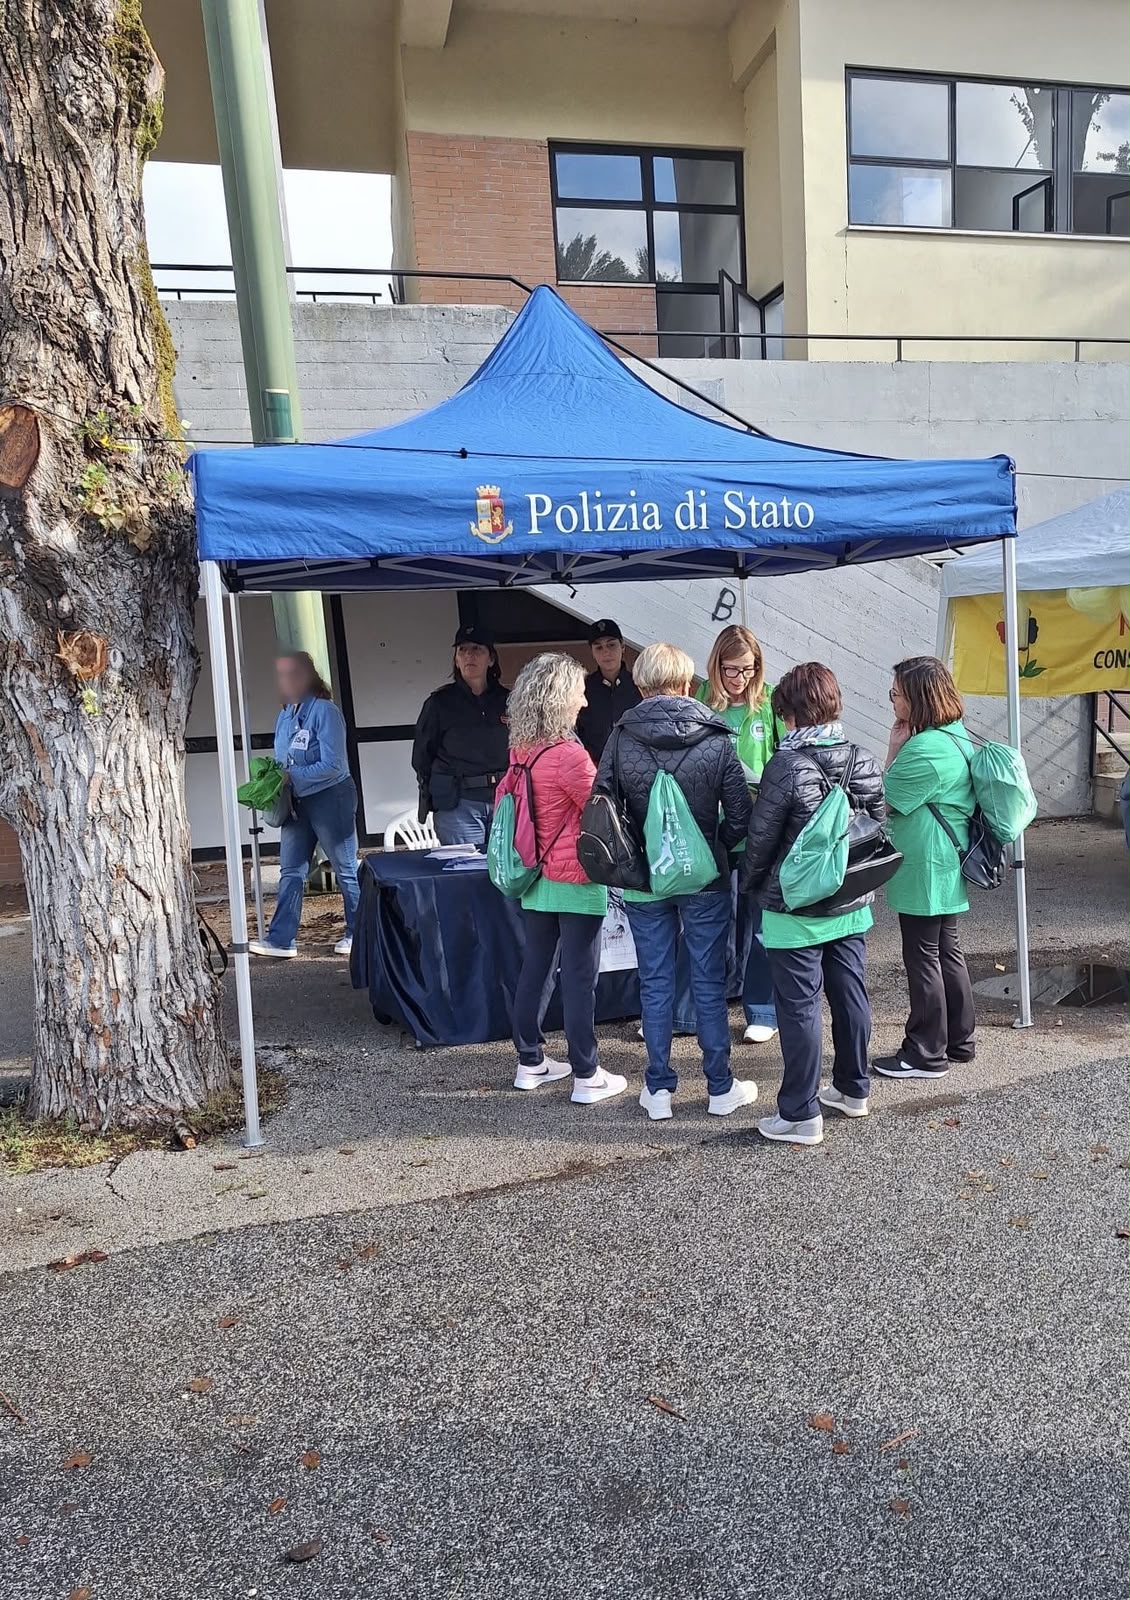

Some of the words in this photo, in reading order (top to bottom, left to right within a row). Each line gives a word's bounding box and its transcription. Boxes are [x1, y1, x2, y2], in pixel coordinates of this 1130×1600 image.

[525, 490, 663, 534] Polizia
[675, 490, 709, 531] di
[723, 490, 815, 529] Stato
[711, 587, 737, 622] B
